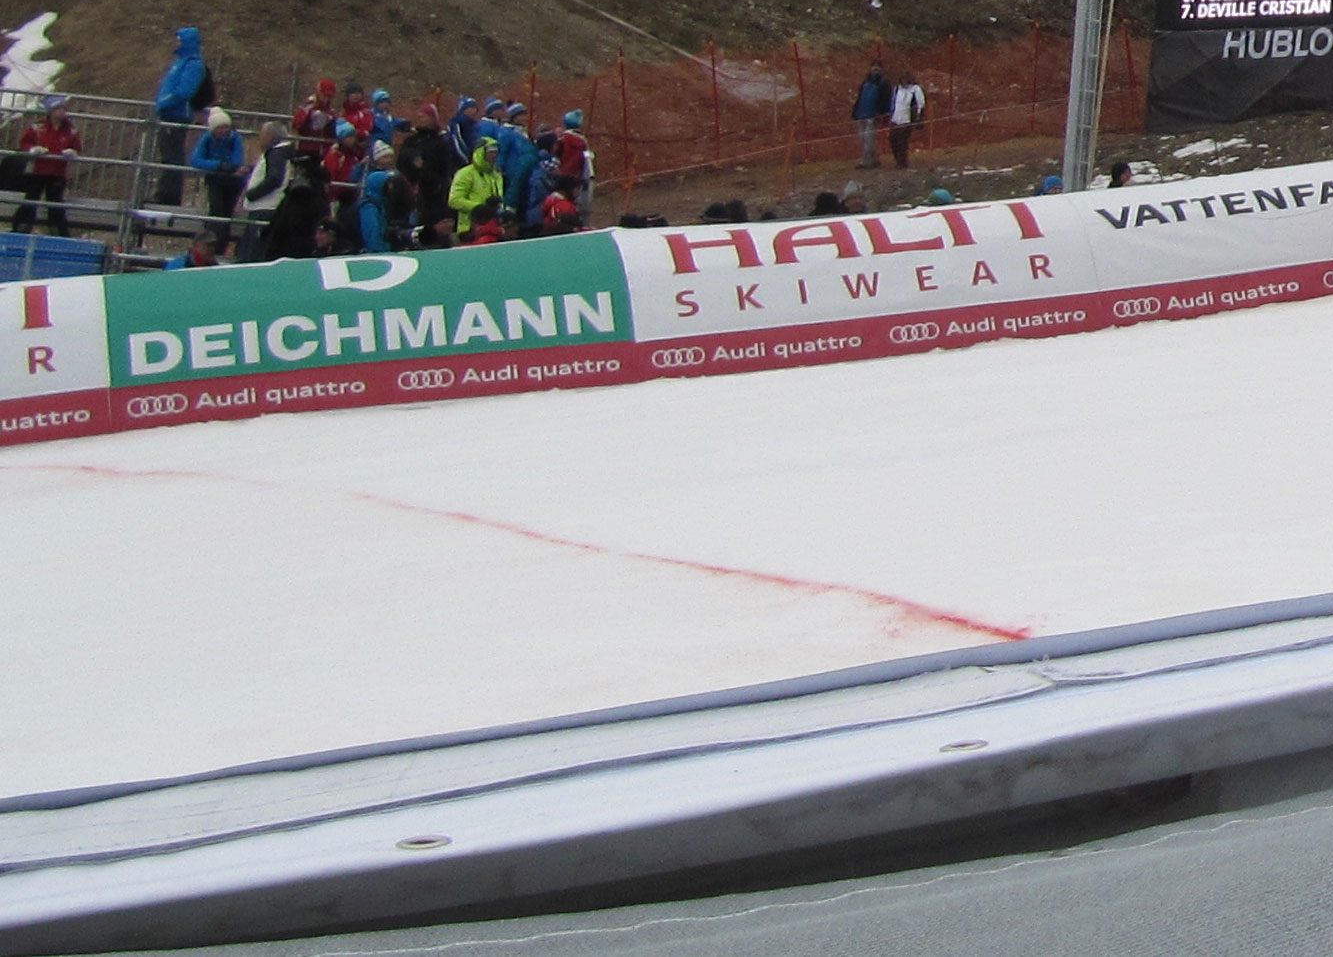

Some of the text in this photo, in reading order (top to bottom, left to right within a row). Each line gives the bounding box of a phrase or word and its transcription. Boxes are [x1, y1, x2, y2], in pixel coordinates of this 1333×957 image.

[1181, 5, 1194, 19] 7.
[1197, 1, 1257, 18] DEVILLE
[662, 202, 1045, 275] HALTI
[675, 254, 1055, 317] SKIWEAR
[1166, 280, 1300, 311] Audi quattro
[128, 290, 615, 377] DEICHMANN
[946, 309, 1086, 337] Audi quattro
[712, 334, 863, 362] Audi quattro
[461, 357, 621, 384] Audi quattro
[196, 379, 366, 409] Audi quattro
[0, 408, 91, 431] uattro
